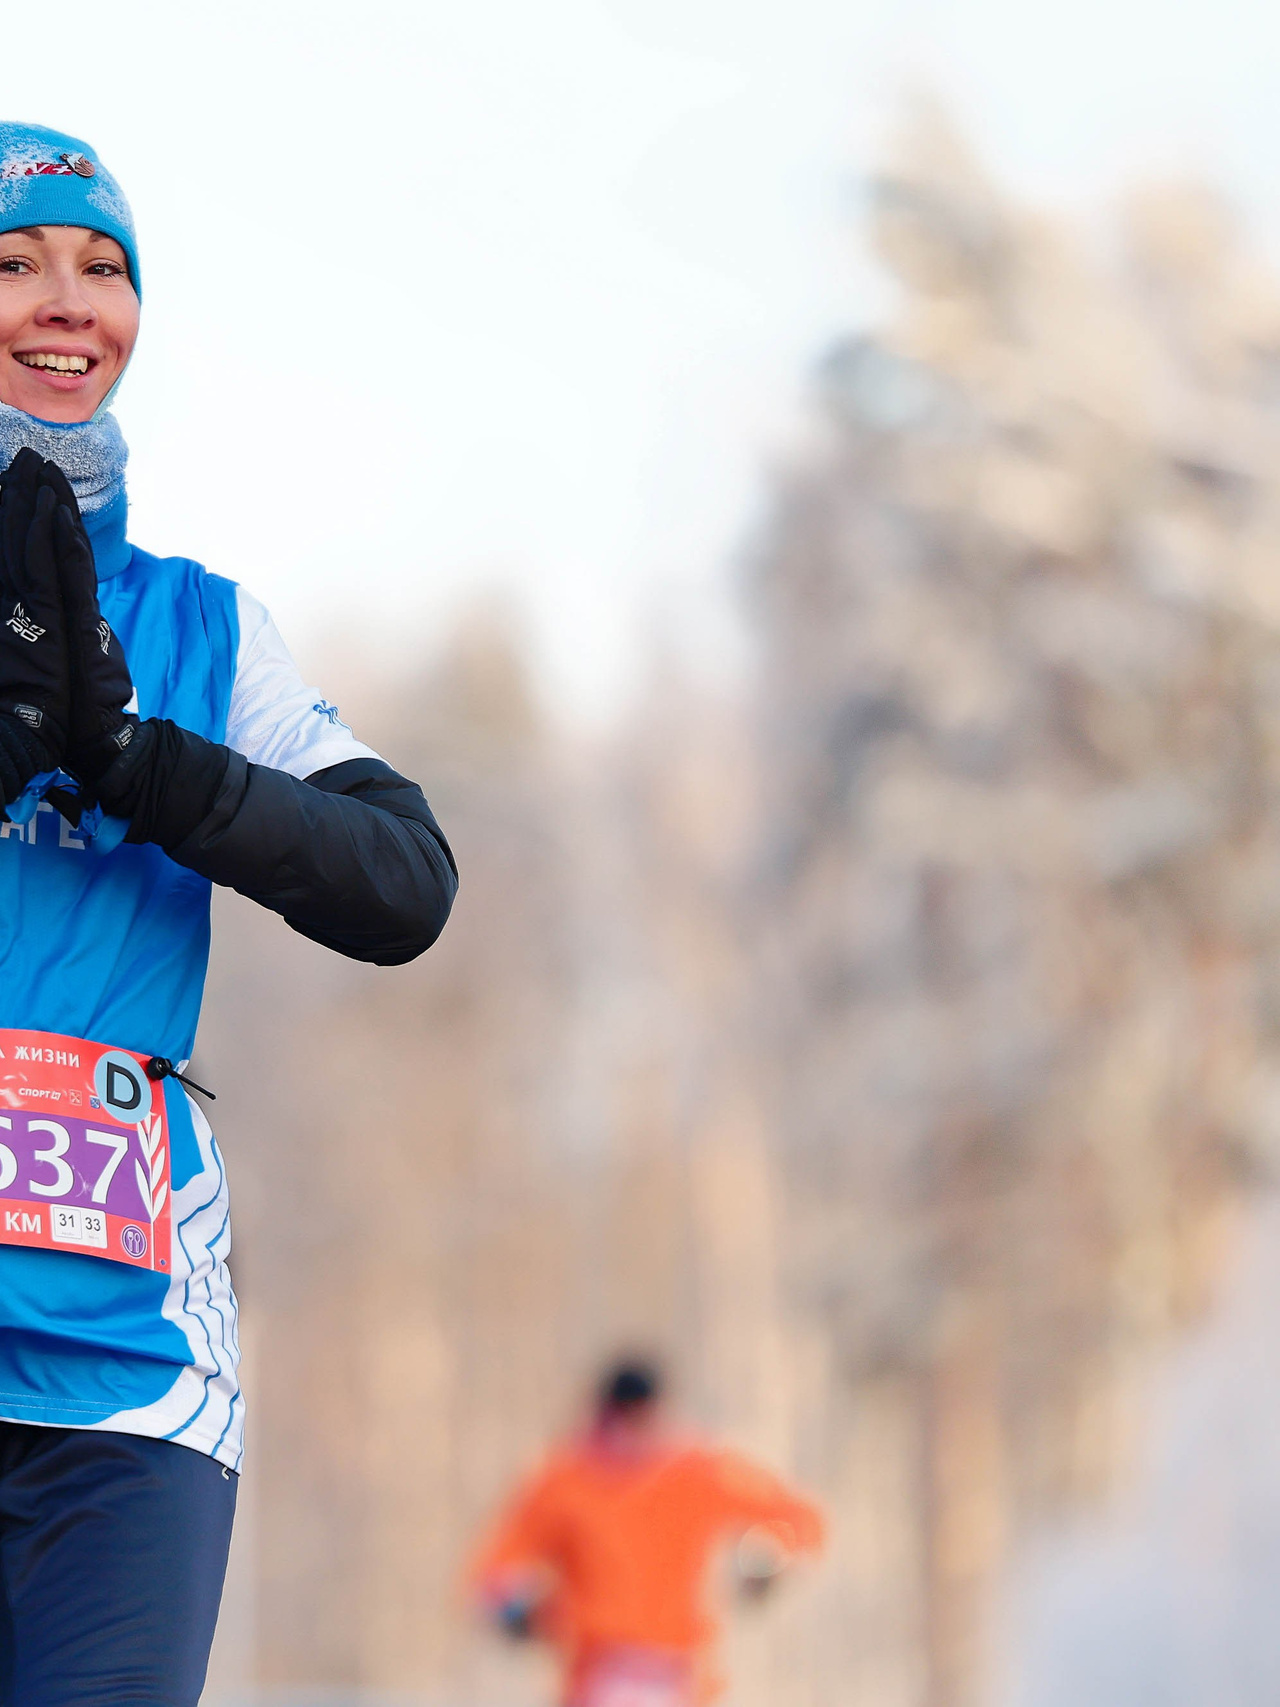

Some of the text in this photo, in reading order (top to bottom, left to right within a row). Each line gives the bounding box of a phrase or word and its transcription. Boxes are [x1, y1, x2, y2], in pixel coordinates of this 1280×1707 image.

[15, 1045, 81, 1068] ЖИЗНИ
[106, 1061, 142, 1110] D
[58, 1212, 102, 1232] 31 33
